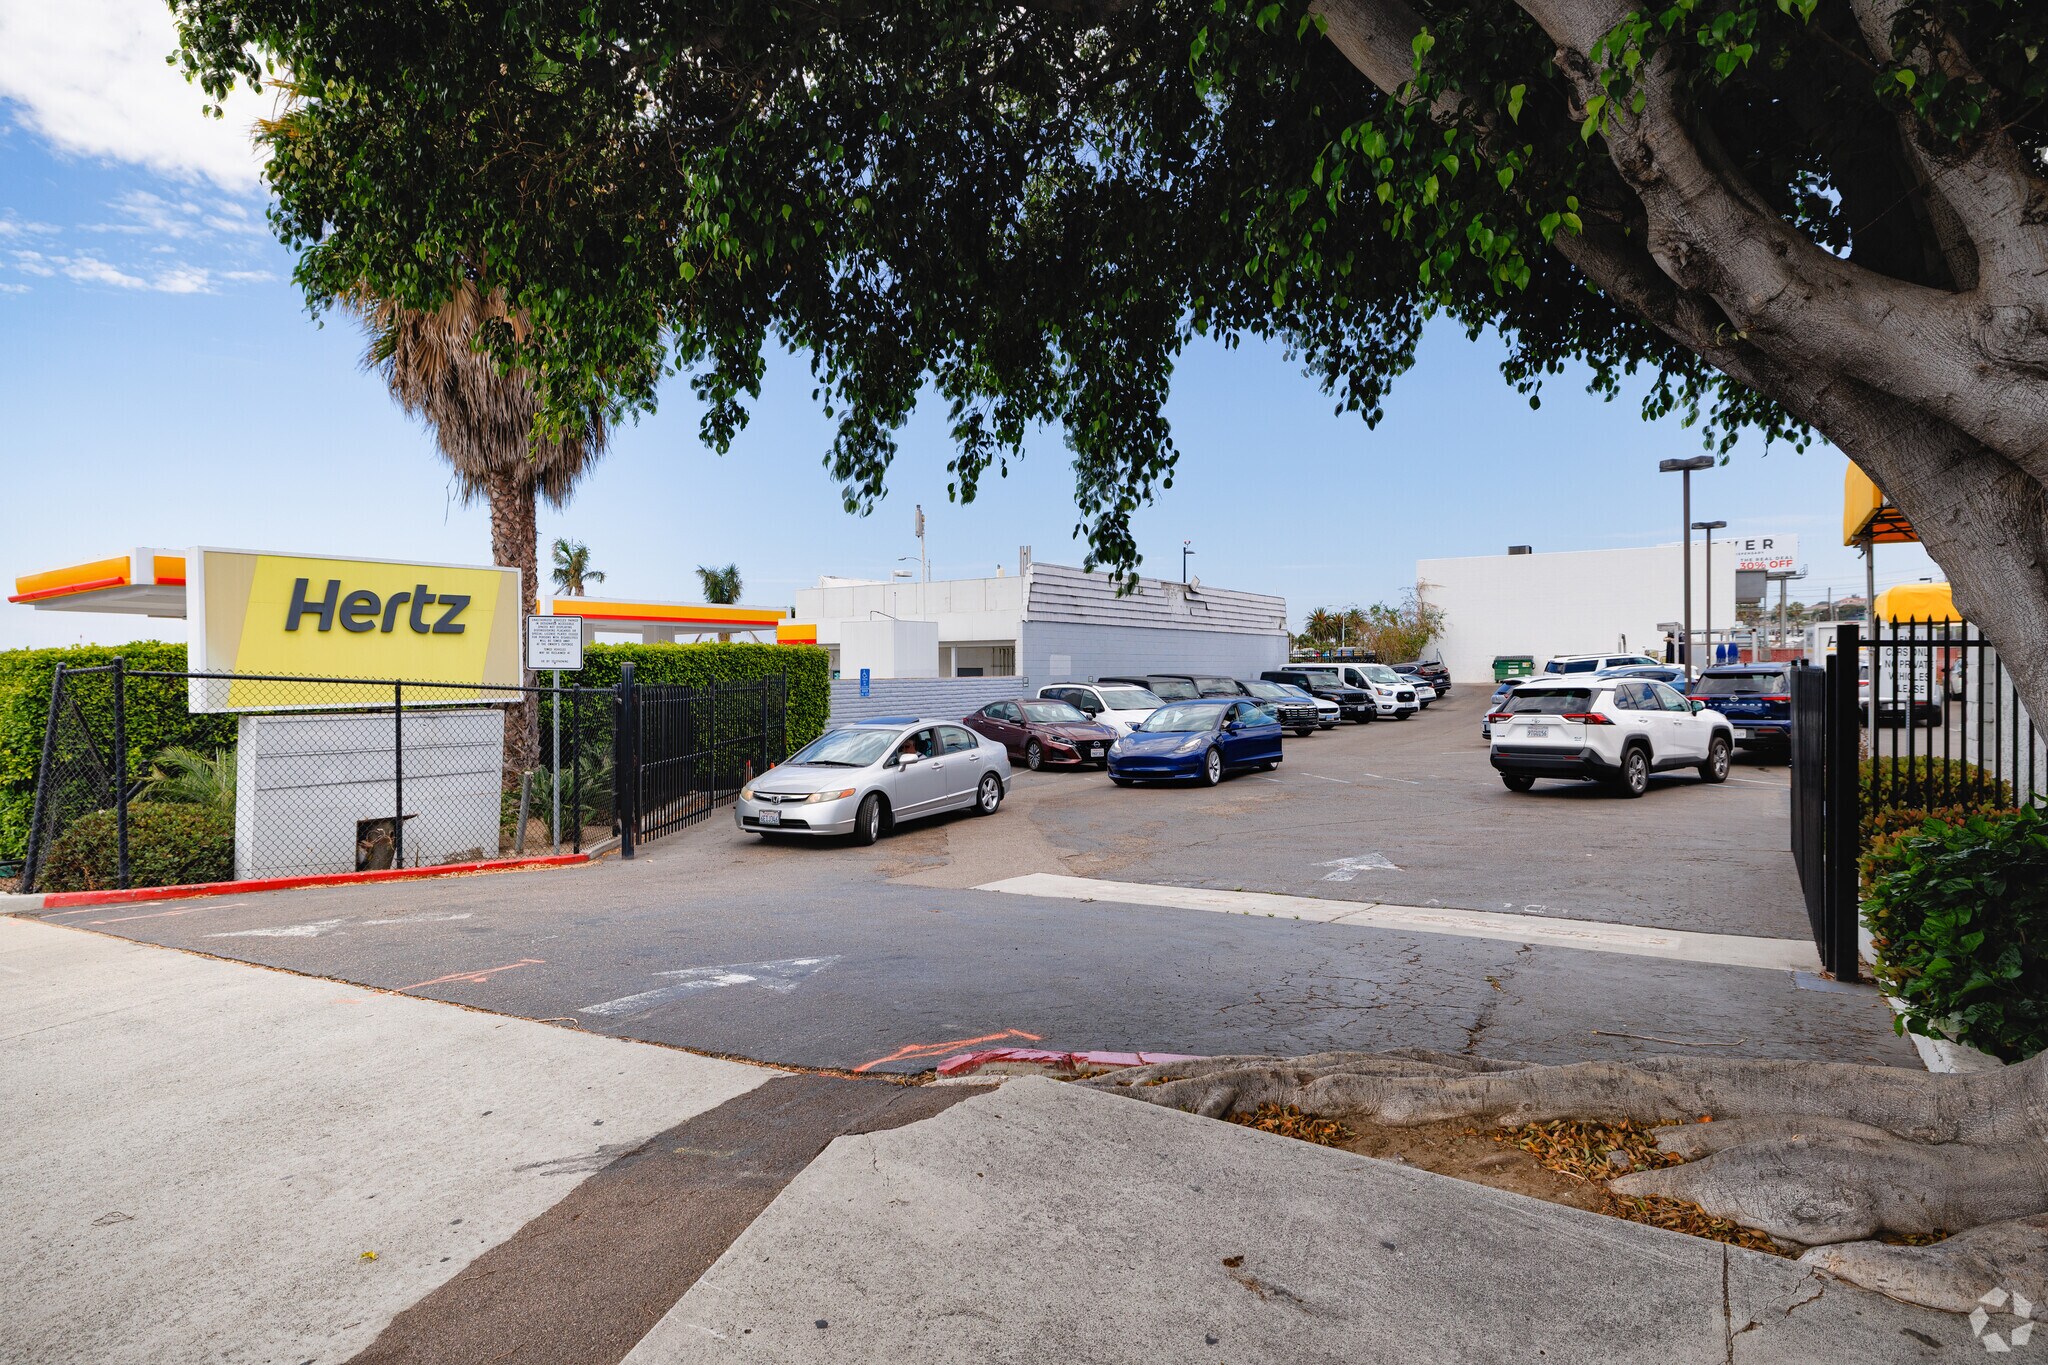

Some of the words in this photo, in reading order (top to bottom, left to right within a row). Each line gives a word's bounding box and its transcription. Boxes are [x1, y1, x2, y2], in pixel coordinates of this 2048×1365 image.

[1740, 561, 1766, 570] 30%
[1769, 560, 1793, 568] OFF
[285, 577, 471, 634] Hertz
[1886, 648, 1908, 656] CRS
[1899, 660, 1934, 669] PRVAT
[1888, 672, 1929, 681] VHIES
